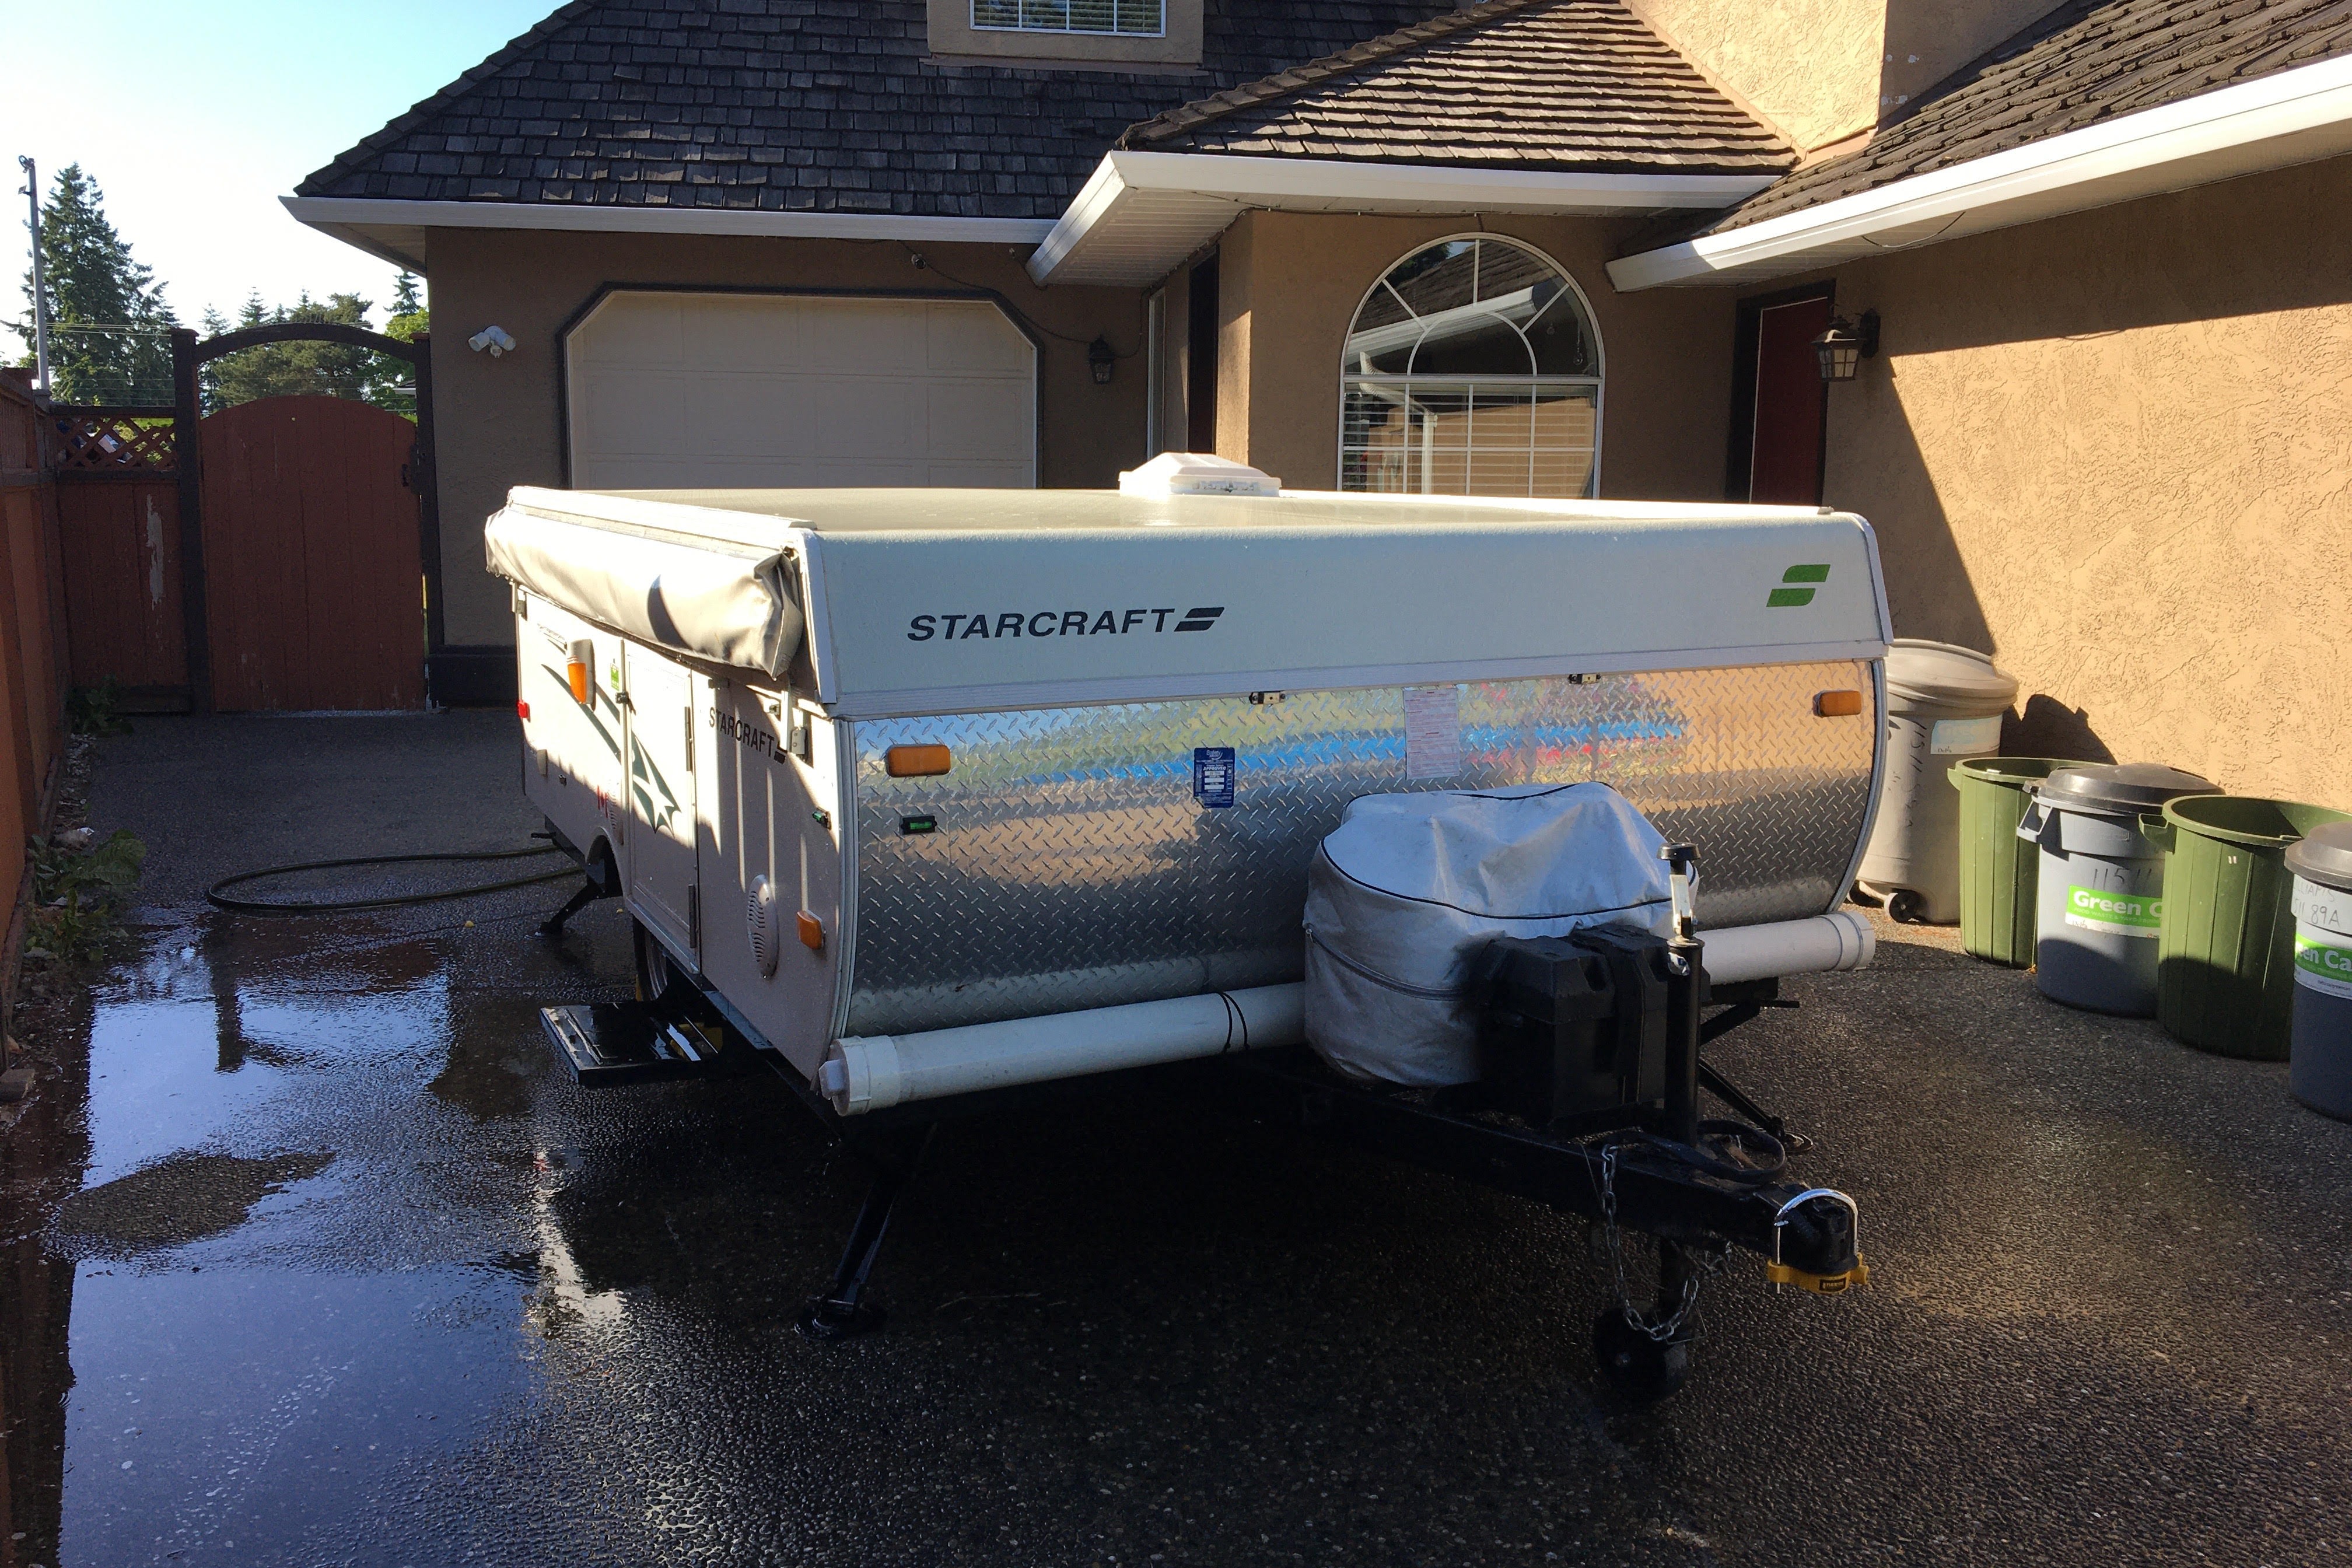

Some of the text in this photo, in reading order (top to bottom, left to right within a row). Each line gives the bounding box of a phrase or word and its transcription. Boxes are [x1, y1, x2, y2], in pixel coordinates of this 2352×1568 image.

[907, 608, 1175, 641] STARCRAFT
[709, 706, 775, 757] STARCRAFT
[2073, 890, 2141, 916] Green
[2311, 904, 2341, 929] 89A
